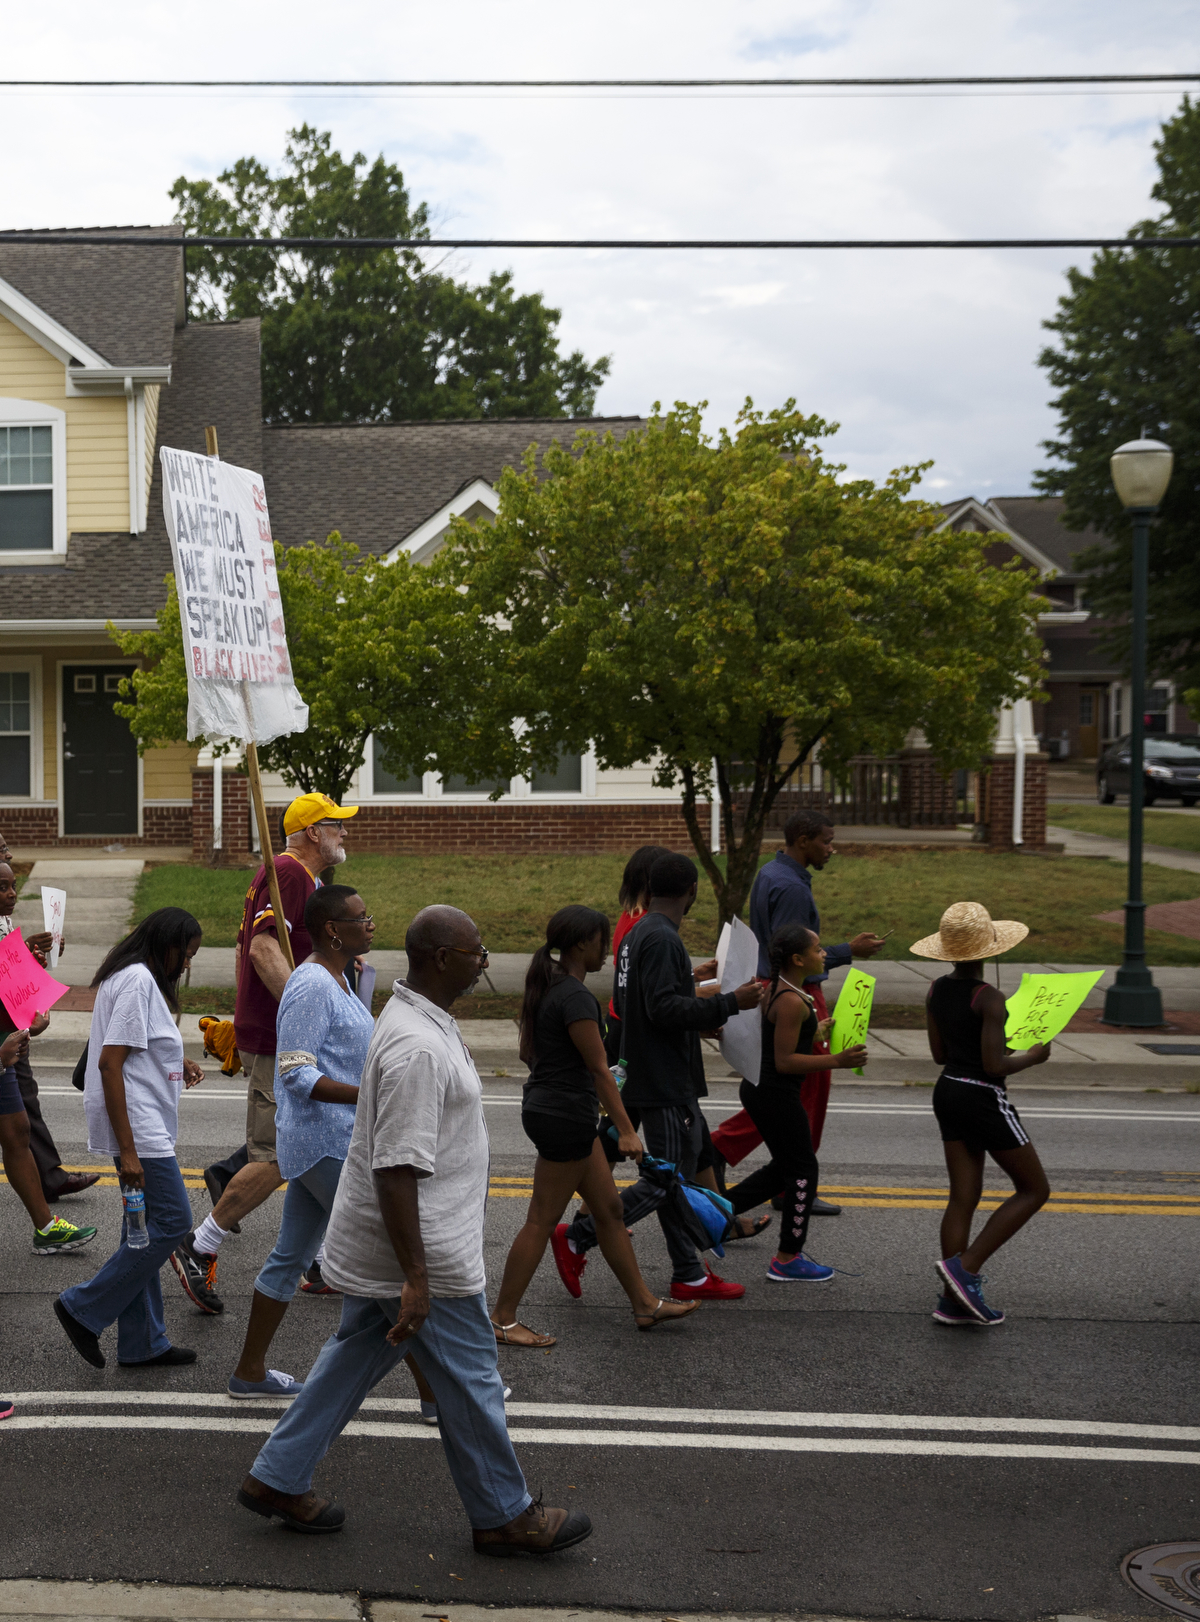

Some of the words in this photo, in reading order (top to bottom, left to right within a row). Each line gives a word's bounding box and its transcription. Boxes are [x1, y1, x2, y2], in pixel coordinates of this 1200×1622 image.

[164, 450, 219, 503] WHITE
[176, 499, 246, 554] AMERICA
[180, 548, 208, 593] WE
[214, 553, 256, 600] MUST
[186, 596, 244, 646] SPEAK
[192, 645, 236, 680] BLACK
[239, 650, 275, 683] LIVES
